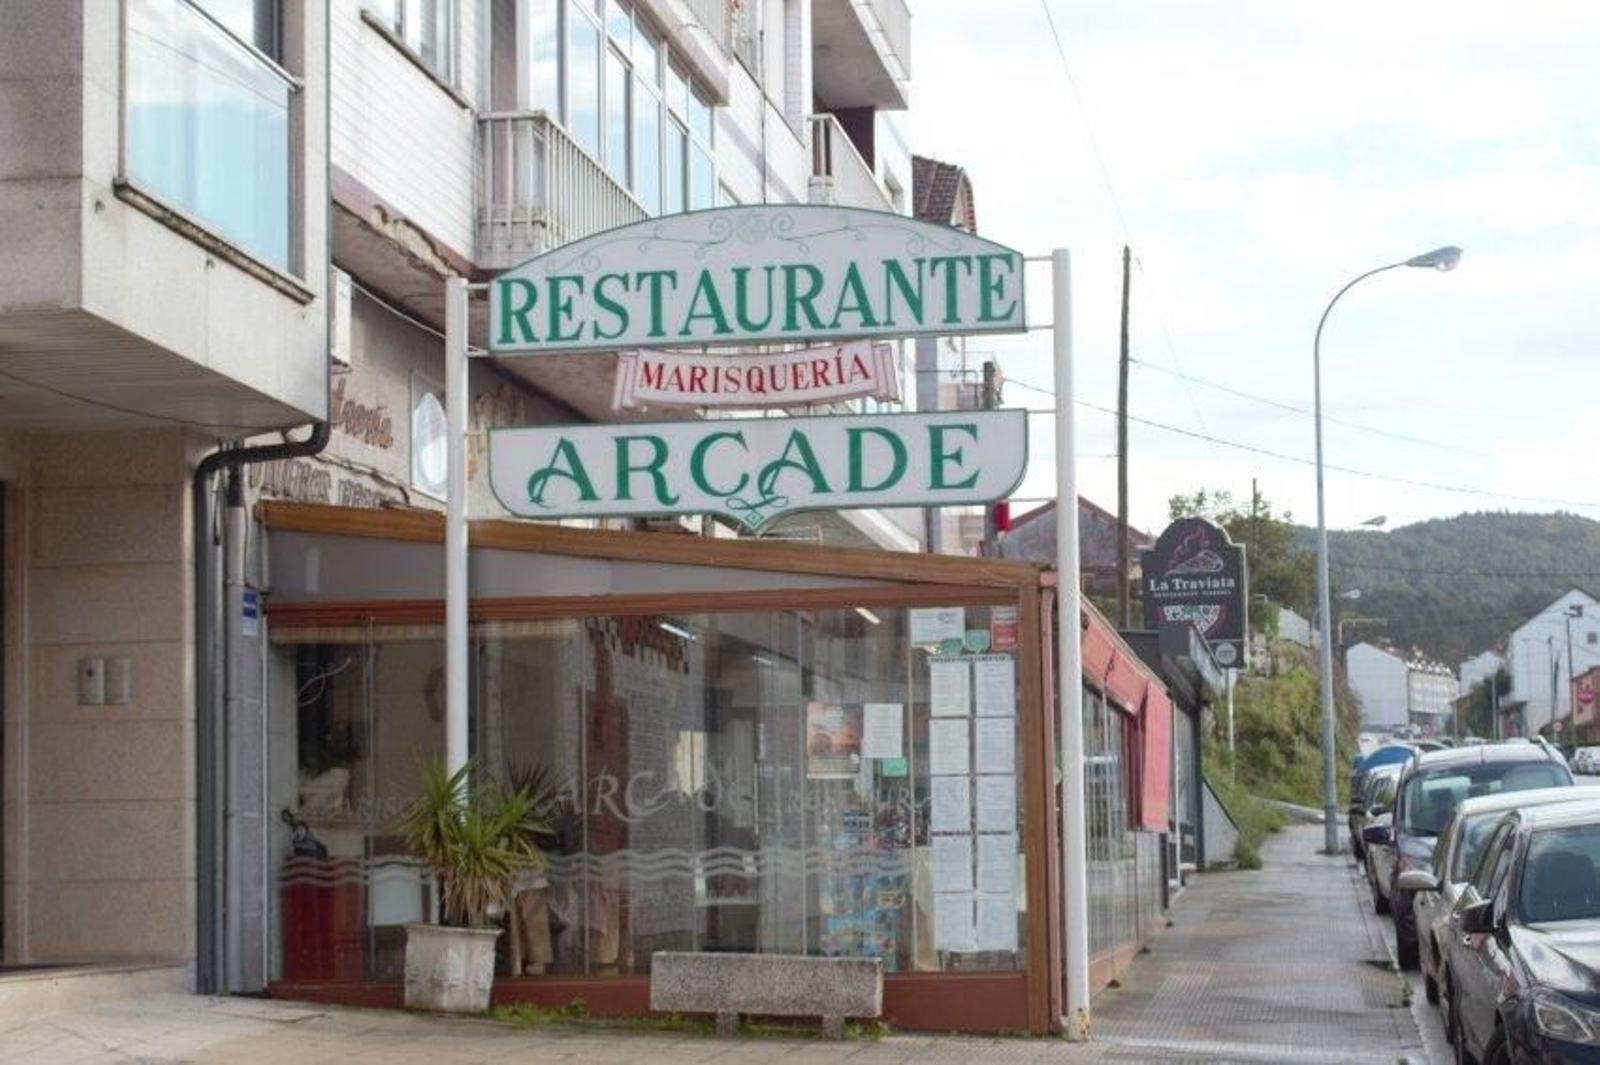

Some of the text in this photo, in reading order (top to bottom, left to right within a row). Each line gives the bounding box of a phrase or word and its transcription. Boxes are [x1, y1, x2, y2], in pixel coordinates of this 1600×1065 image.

[496, 253, 1017, 346] RESTAURANTE
[641, 348, 872, 394] MARISQUERÍA
[527, 424, 981, 509] ARCADE
[1149, 576, 1235, 591] La Traviata
